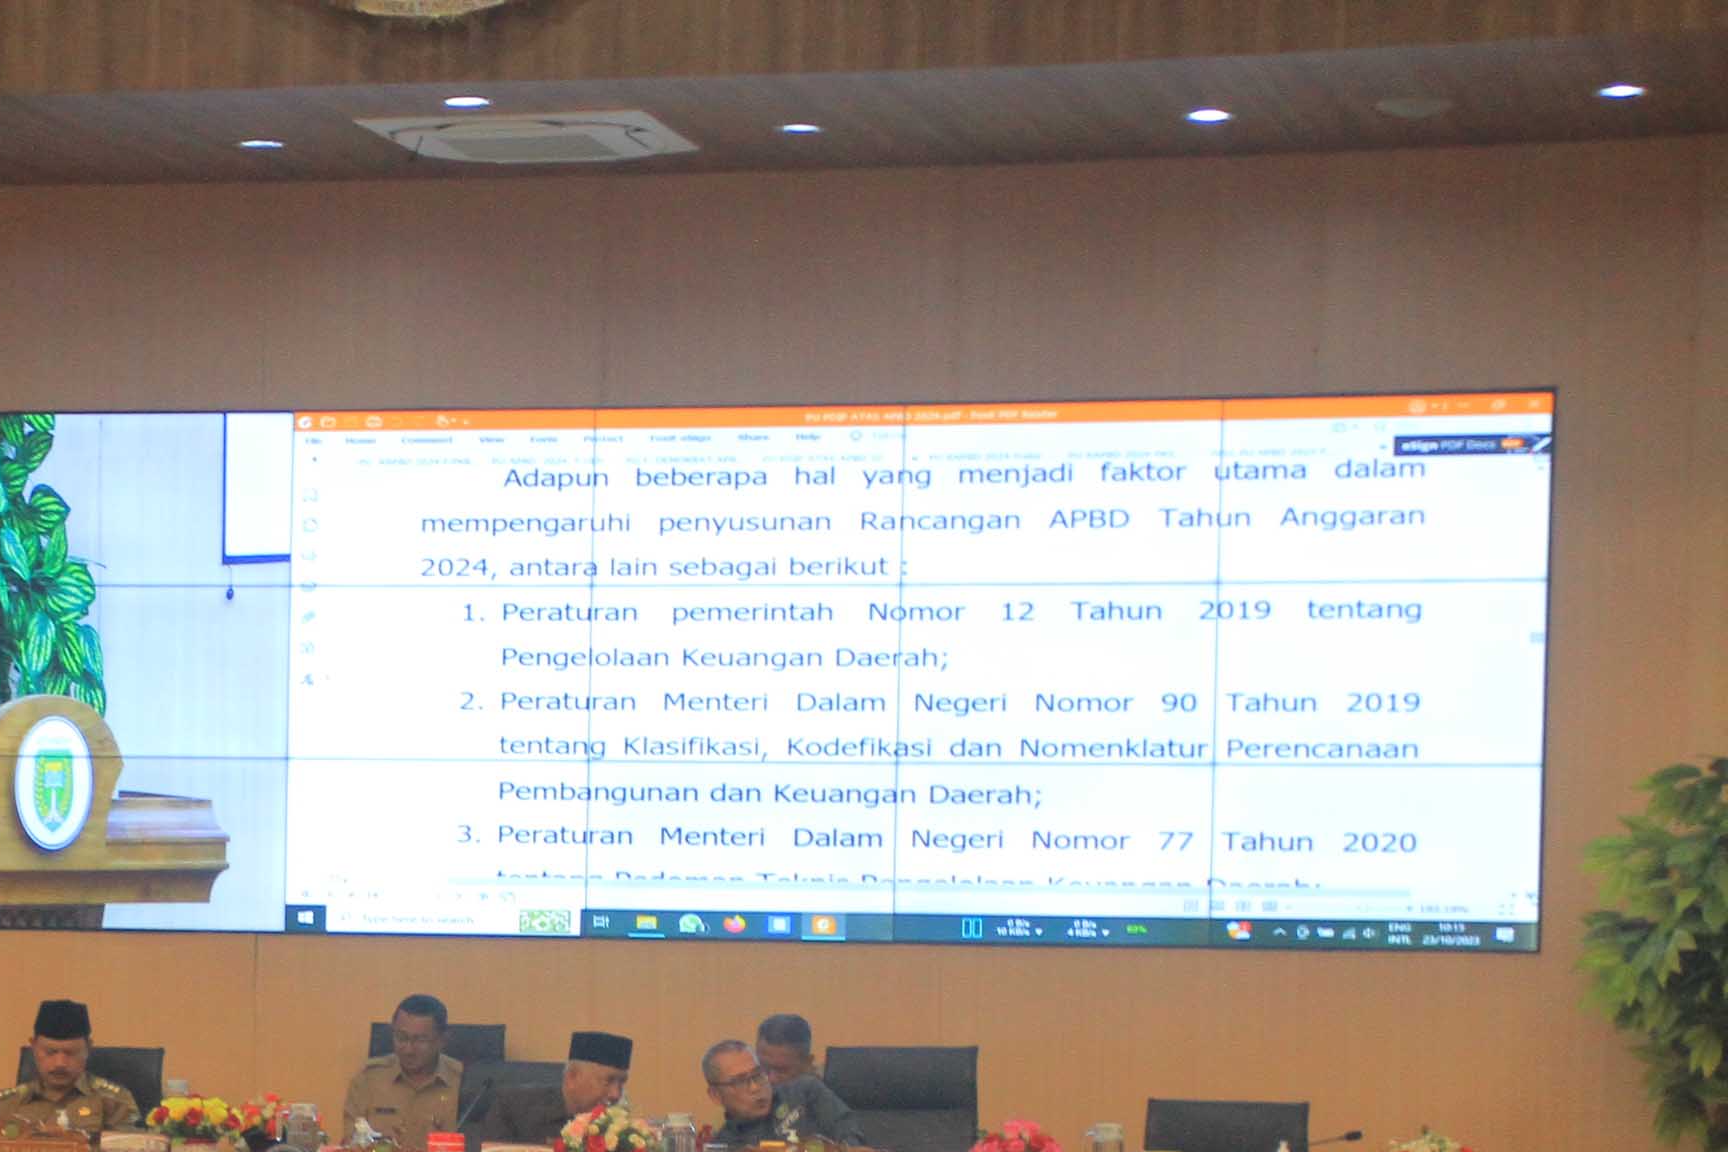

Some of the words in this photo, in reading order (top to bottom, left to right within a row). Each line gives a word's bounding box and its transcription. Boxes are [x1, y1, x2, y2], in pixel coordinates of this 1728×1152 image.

[503, 466, 609, 492] Adapun
[635, 466, 768, 491] beberapa
[794, 464, 836, 486] hal
[862, 465, 932, 490] yang
[958, 460, 1073, 489] menjadi
[1100, 460, 1187, 482] faktor
[1214, 459, 1308, 483] utama
[1334, 456, 1427, 480] dalam
[421, 513, 631, 538] mempengaruhi
[659, 515, 832, 537] penyusunan
[860, 511, 1021, 535] Rancangan
[1049, 508, 1131, 529] APBD
[1158, 507, 1252, 529] Tahun
[1279, 506, 1426, 532] Anggaran
[420, 557, 497, 582] 2024,
[509, 558, 598, 578] antara
[610, 557, 658, 577] lain
[669, 557, 777, 582] sebagai
[789, 556, 889, 577] berikut
[463, 603, 485, 622] 1.
[502, 602, 638, 623] Peraturan
[672, 601, 834, 626] pemerintah
[868, 602, 966, 623] Nomor
[1003, 601, 1035, 622] 12
[1071, 600, 1163, 622] Tahun
[1199, 599, 1272, 621] 2019
[1307, 599, 1423, 625] tentang
[501, 646, 670, 672] Pengelolaan
[682, 647, 823, 673] Keuangan
[835, 647, 948, 672] Daerah;
[459, 690, 484, 711] 2.
[500, 691, 637, 713] Peraturan
[663, 692, 768, 712] Menteri
[796, 692, 886, 713] Dalam
[914, 692, 1007, 718] Negeri
[1035, 692, 1135, 713] Nomor
[1161, 692, 1198, 713] 90
[1226, 691, 1318, 713] Tahun
[1346, 691, 1422, 713] 2019
[499, 735, 607, 760] tentang
[623, 735, 769, 762] Klasifikasi,
[787, 736, 932, 759] Kodefikasi
[949, 737, 1003, 758] dan
[1020, 737, 1209, 759] Nomenklatur
[1226, 738, 1419, 759] Perencanaan
[498, 781, 699, 807] Pembangunan
[709, 782, 762, 803] dan
[774, 783, 917, 809] Keuangan
[929, 784, 1041, 809] Daerah;
[457, 824, 481, 844] 3.
[498, 824, 634, 846] Peraturan
[660, 826, 765, 847] Menteri
[793, 827, 883, 849] Dalam
[911, 829, 1004, 854] Negeri
[1032, 829, 1131, 850] Nomor
[1159, 831, 1195, 852] 77
[1222, 831, 1314, 853] Tahun
[1343, 831, 1419, 854] 2020
